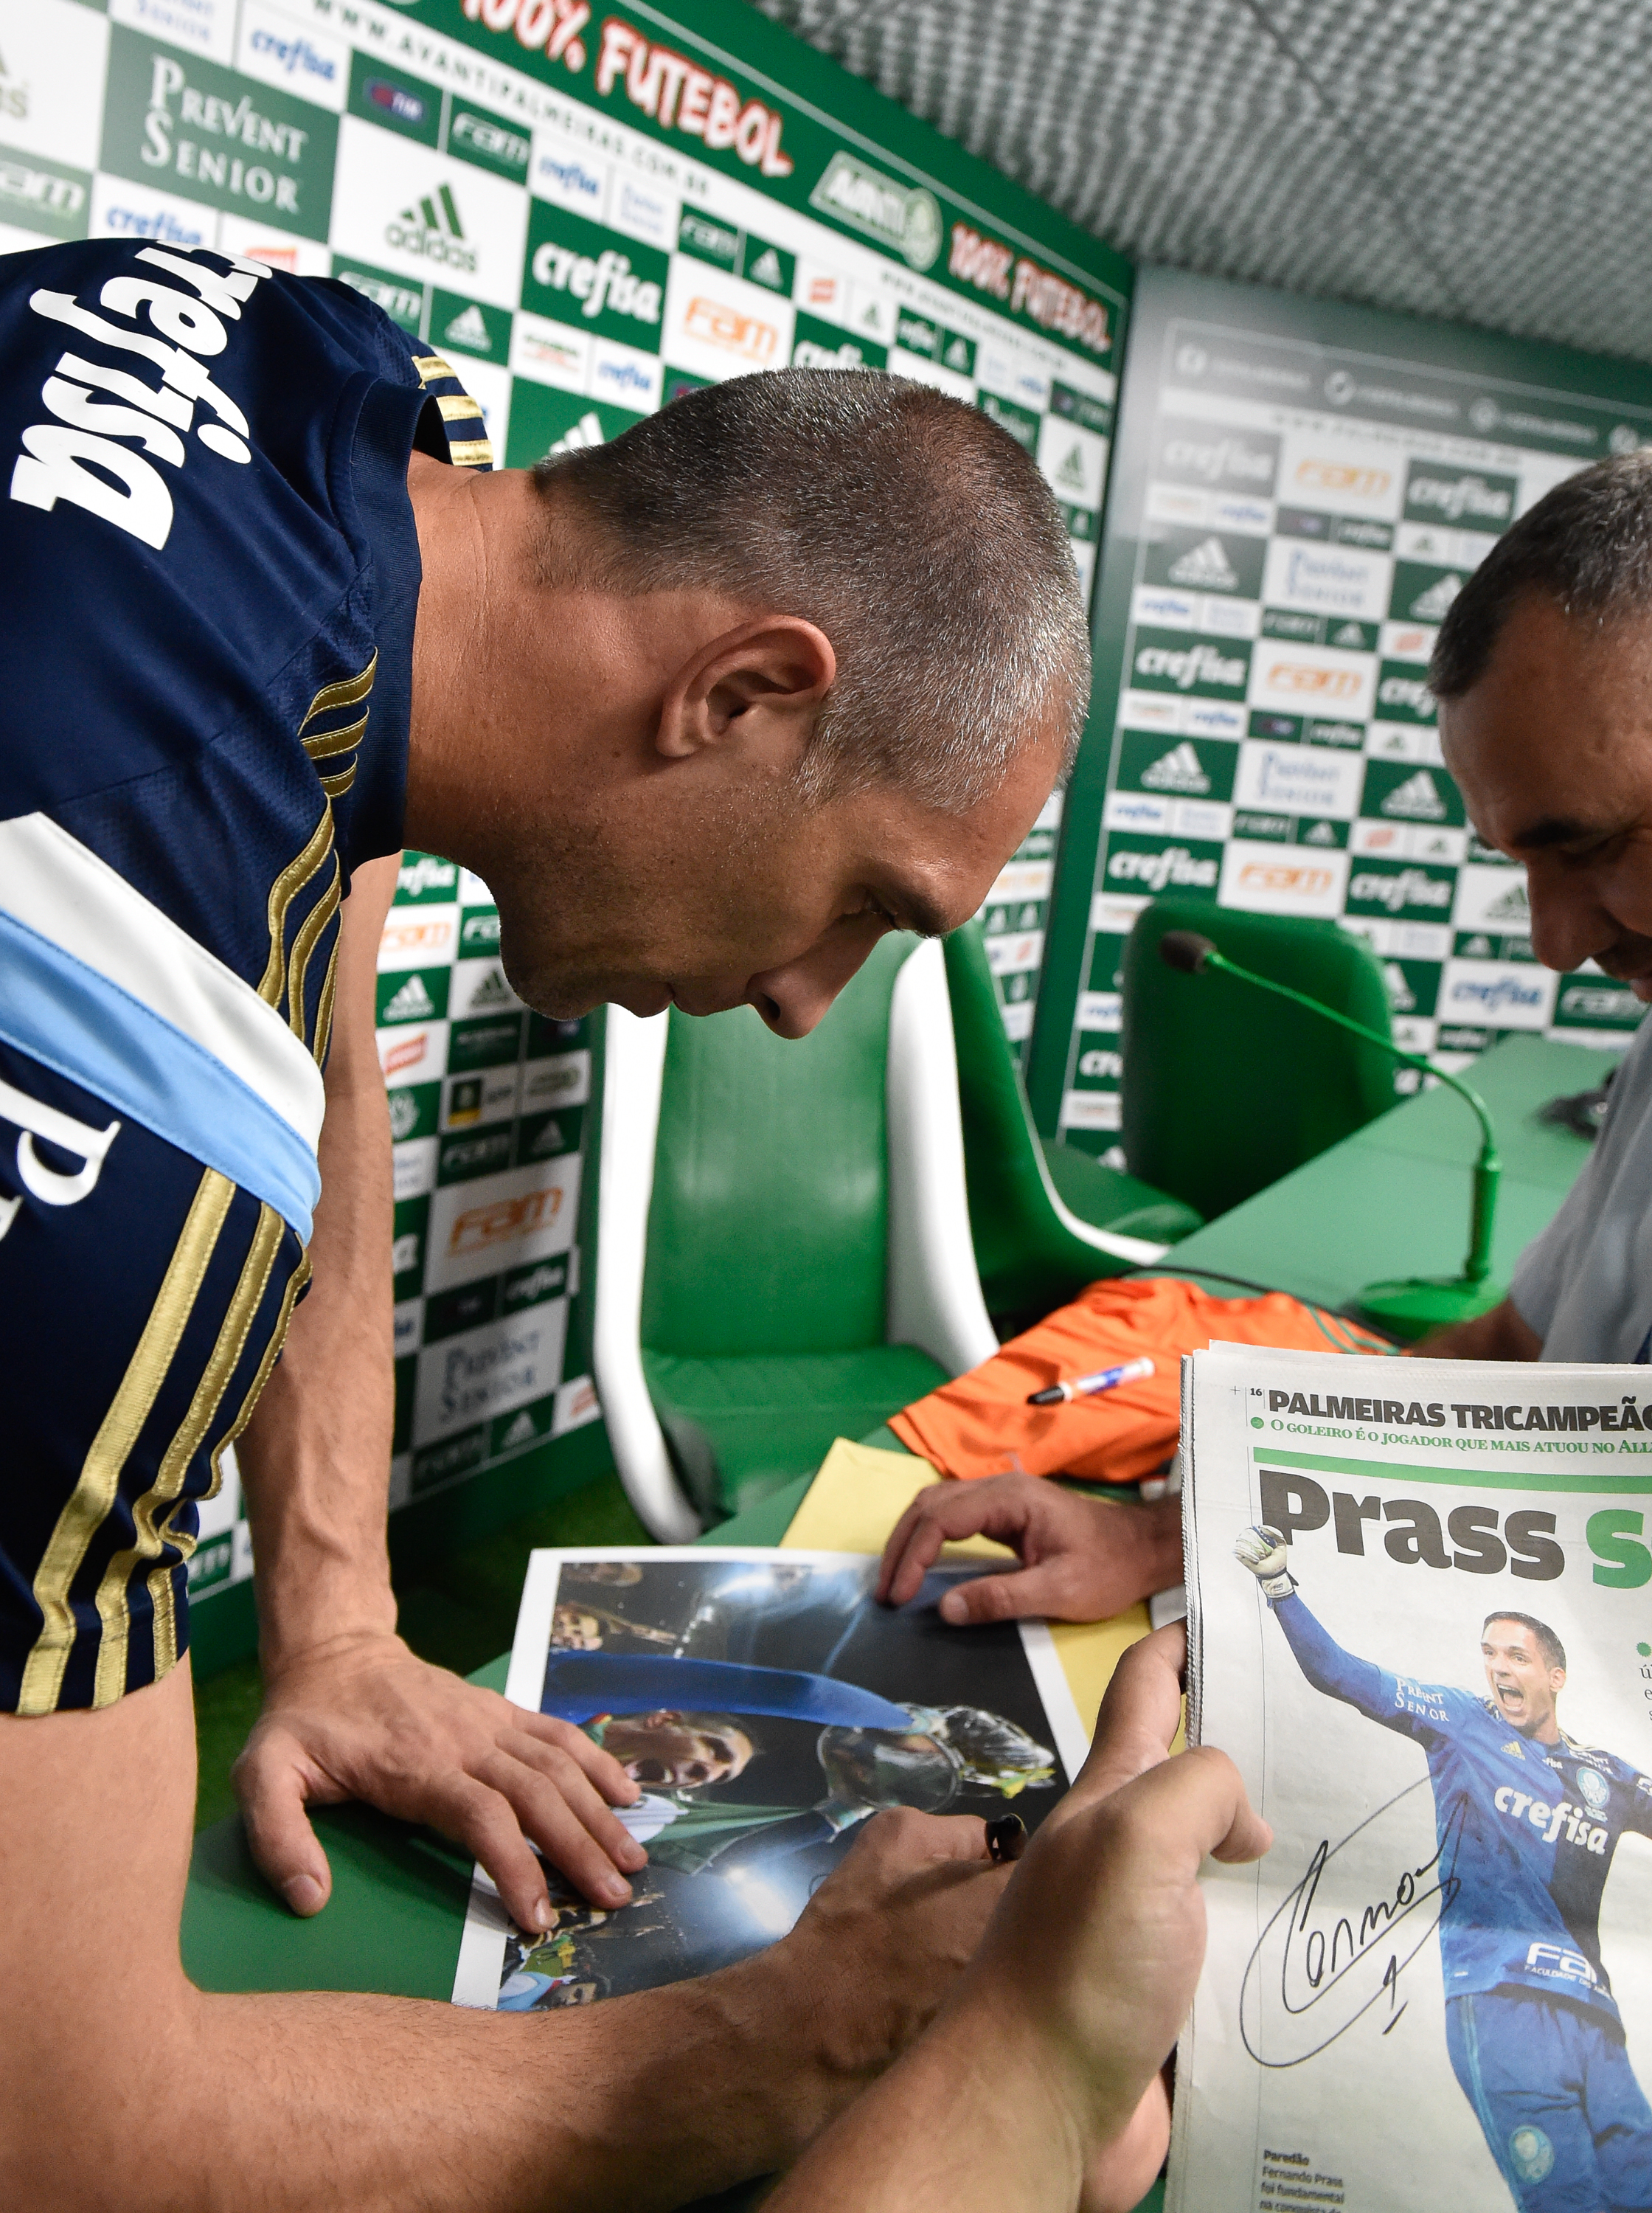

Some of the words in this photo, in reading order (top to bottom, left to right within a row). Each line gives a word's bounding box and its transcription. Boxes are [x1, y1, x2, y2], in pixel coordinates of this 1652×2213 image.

[150, 52, 308, 163] PREVENT
[595, 16, 794, 177] FUTEBOL
[140, 109, 301, 215] SENIOR
[384, 223, 479, 274] adidas
[532, 242, 663, 324] crefisa
[1250, 1388, 1263, 1396] 16
[1268, 1389, 1446, 1427] PALMEIRAS
[1270, 1419, 1284, 1431] O
[1287, 1423, 1353, 1439] GOLEIRO
[1356, 1427, 1366, 1441] É
[1367, 1431, 1379, 1441] O
[1381, 1433, 1453, 1449] JOGADOR
[1455, 1438, 1488, 1452] QUE
[1490, 1440, 1531, 1452] MAIS
[1533, 1441, 1589, 1453] ATUOU
[1592, 1441, 1615, 1453] NO
[1617, 1439, 1652, 1453] ALL
[1259, 1469, 1565, 1581] Prass
[1494, 1787, 1608, 1855] crefisa
[1262, 2165, 1313, 2183] Fernando
[1277, 2183, 1344, 2205] fundamental
